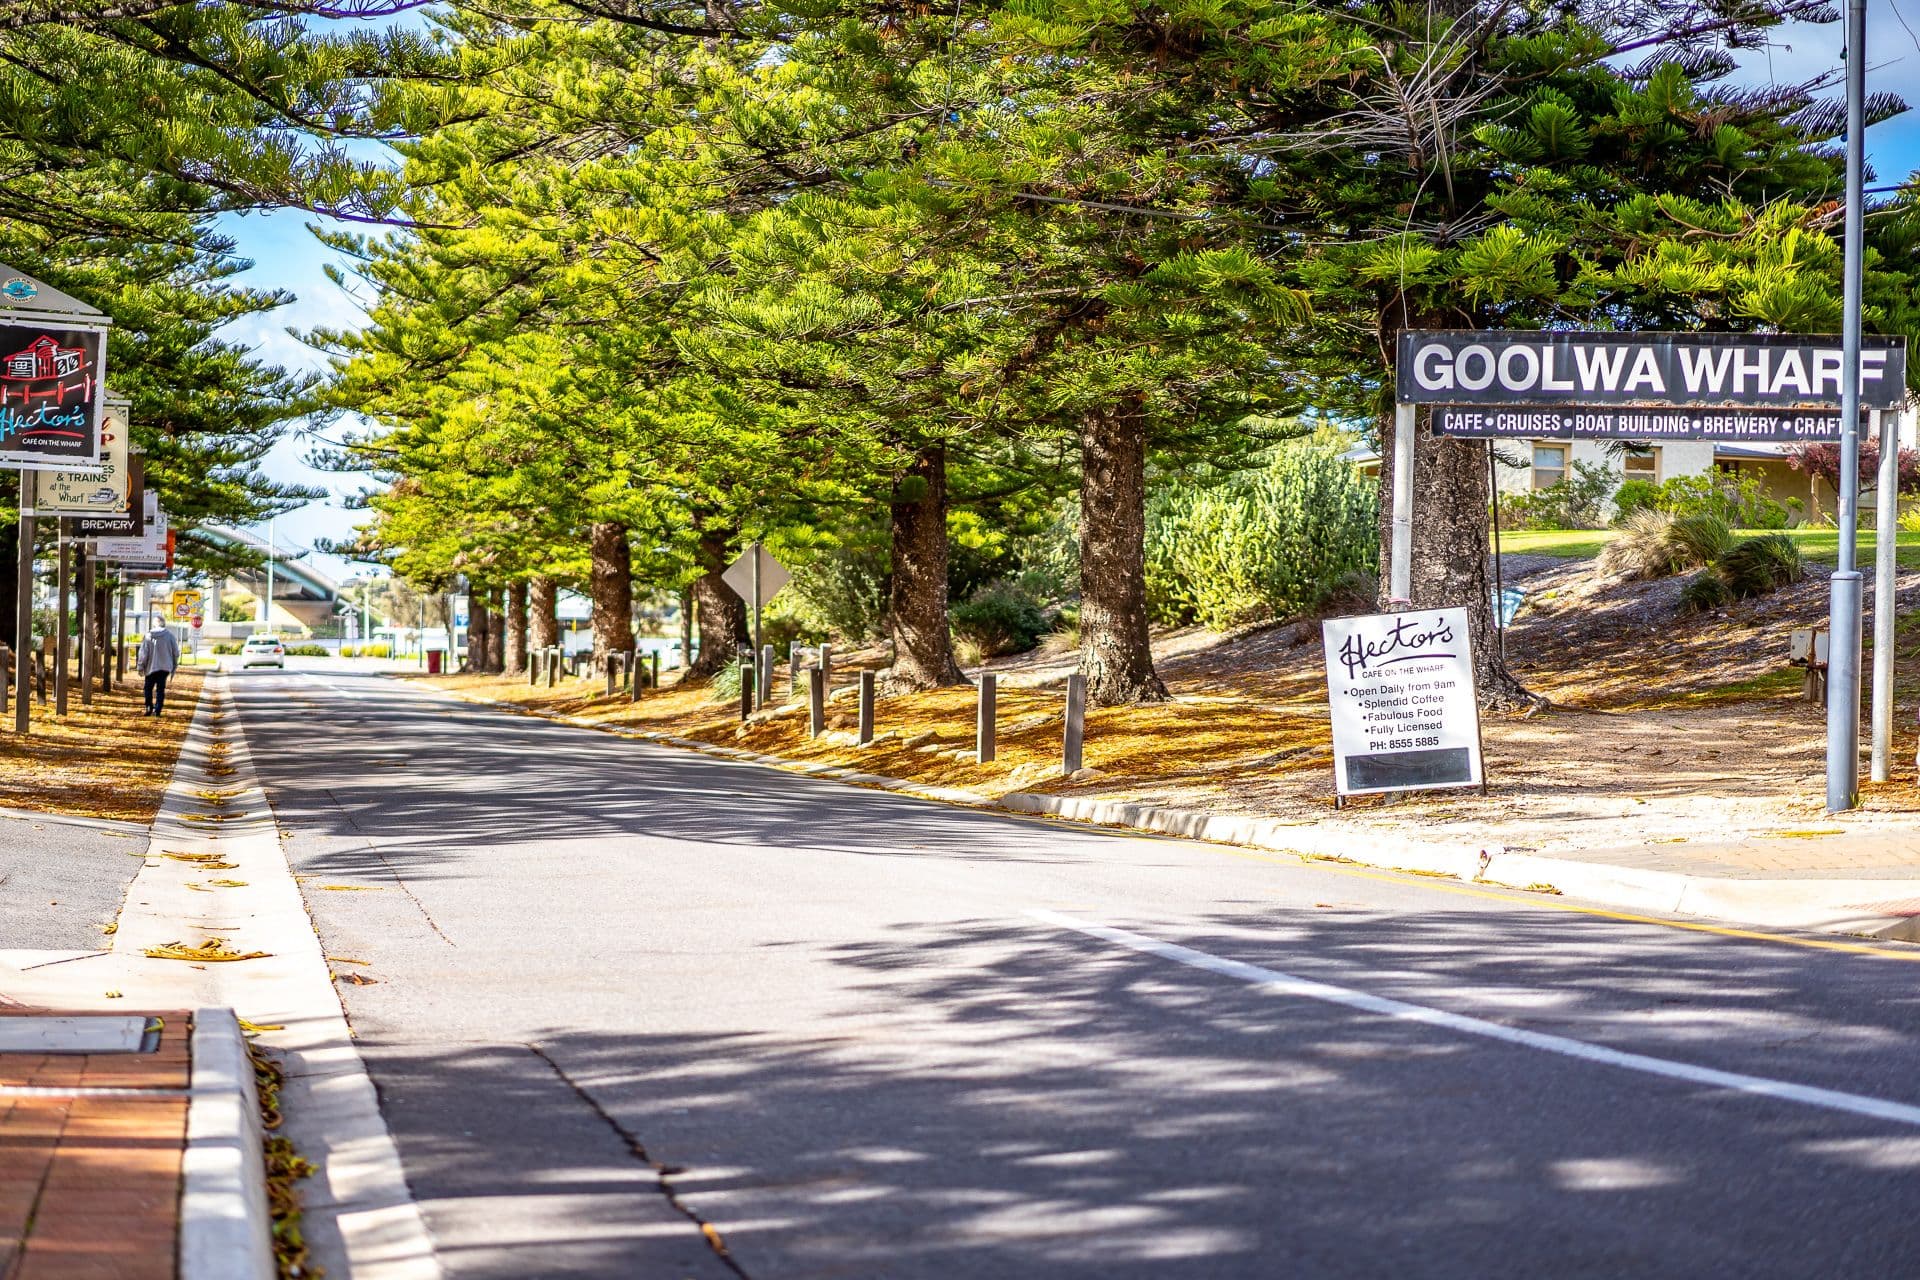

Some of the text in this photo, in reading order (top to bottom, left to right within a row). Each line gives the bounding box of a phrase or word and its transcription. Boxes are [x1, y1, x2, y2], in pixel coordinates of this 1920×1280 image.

[1413, 343, 1887, 396] GOOLWA WHARF
[0, 401, 85, 442] Hector's
[1444, 413, 1482, 430] CAFE
[1496, 414, 1561, 432] CRUISES
[1575, 414, 1613, 432] BOAT
[1618, 415, 1690, 433] BUILDING
[1703, 416, 1779, 434] BREWERY
[49, 439, 60, 447] THE
[60, 440, 82, 448] WHARF
[56, 472, 65, 481] &
[59, 482, 71, 491] the
[59, 493, 84, 503] Wharf
[81, 519, 136, 530] BREWERY
[1338, 617, 1454, 680] Hector's
[1384, 668, 1397, 677] ON
[1399, 666, 1414, 675] THE
[1416, 664, 1445, 674] WHARF
[1350, 679, 1456, 698] Open Daily from 9am
[1364, 693, 1445, 710] Splendid Coffee
[1368, 707, 1443, 721] Fabulous Food
[1370, 720, 1443, 736] Fully Licensed
[1369, 736, 1439, 751] PH: 8555 5885
